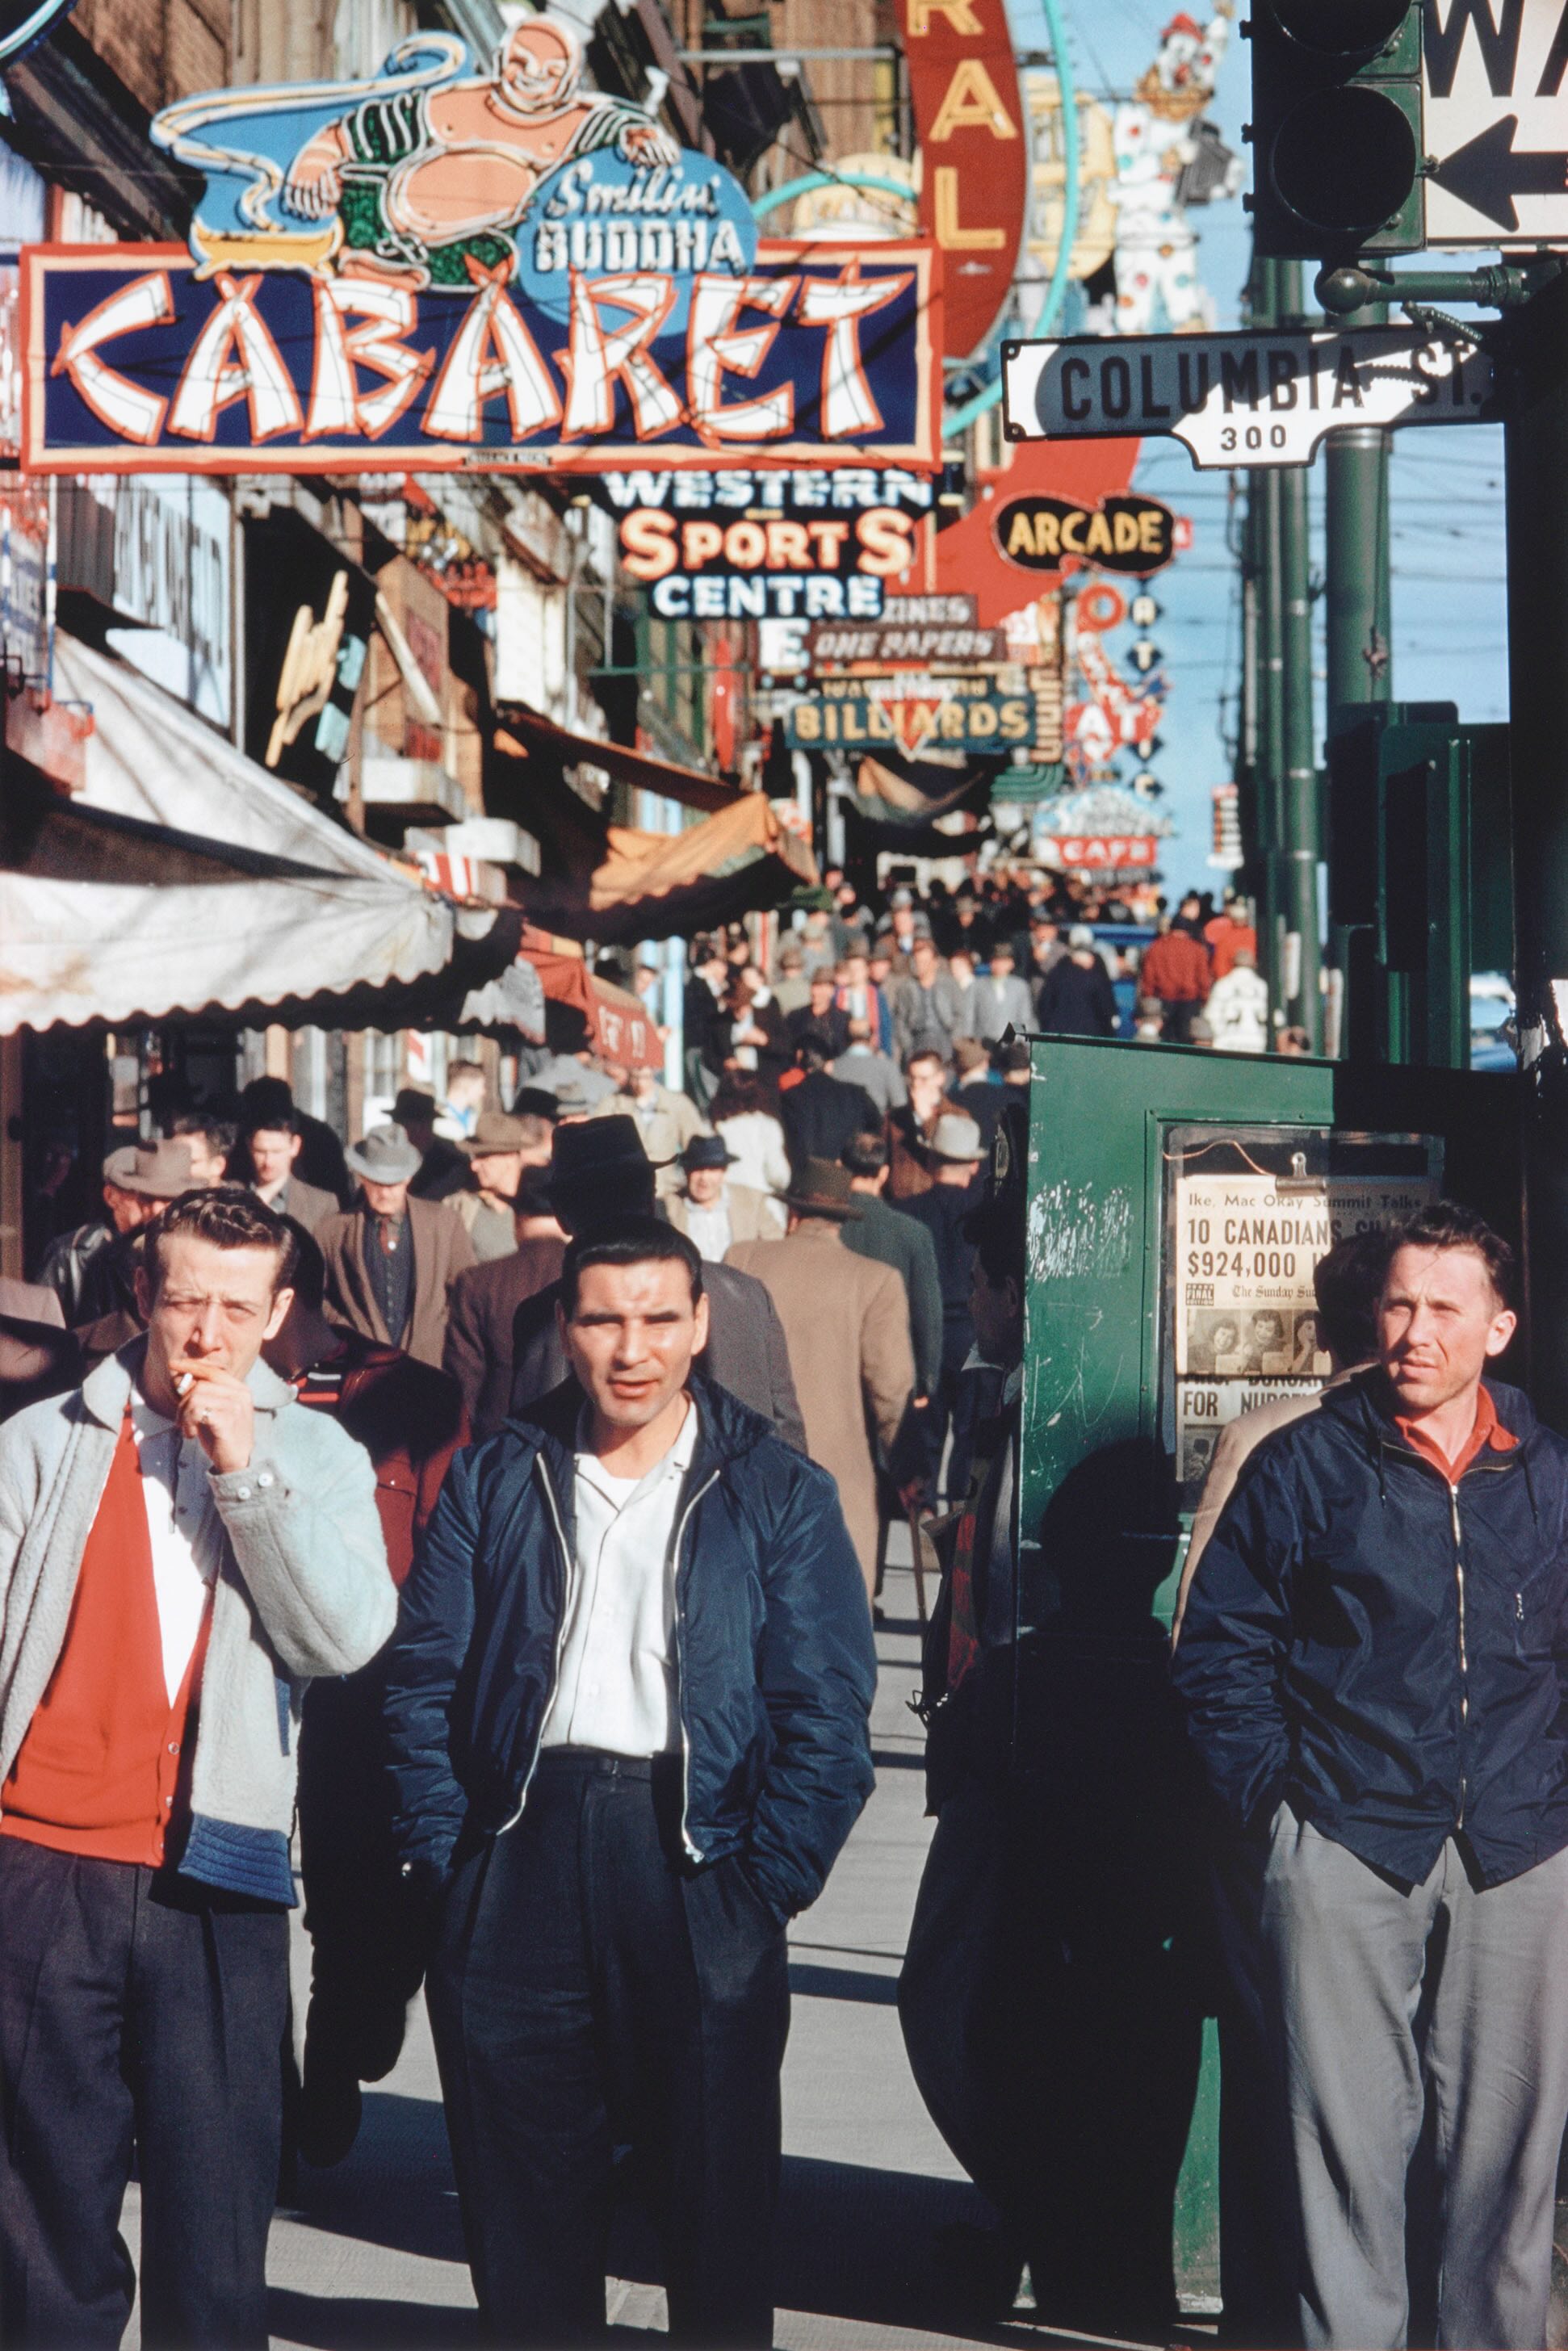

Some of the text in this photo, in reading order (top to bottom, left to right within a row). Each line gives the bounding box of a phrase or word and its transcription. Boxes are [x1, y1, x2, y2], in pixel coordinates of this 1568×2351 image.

[535, 219, 748, 277] BUDDHA
[50, 254, 916, 449] CABARET
[1060, 346, 1366, 421] COLUMBIA
[1220, 425, 1288, 451] 300
[602, 468, 933, 508] WESTERN
[620, 508, 914, 580] SPORTS
[1009, 510, 1163, 556] ARCADE
[652, 574, 883, 617] CENTRE
[1224, 1195, 1256, 1208] Mac
[1313, 1195, 1372, 1209] Summit
[1381, 1193, 1422, 1209] Talks
[1188, 1218, 1210, 1245] 10
[1224, 1218, 1343, 1246] CANADIANS
[1188, 1252, 1296, 1278] $924,000
[1232, 1284, 1251, 1298] The
[1255, 1284, 1293, 1301] Sunday
[1183, 1391, 1218, 1417] FOR
